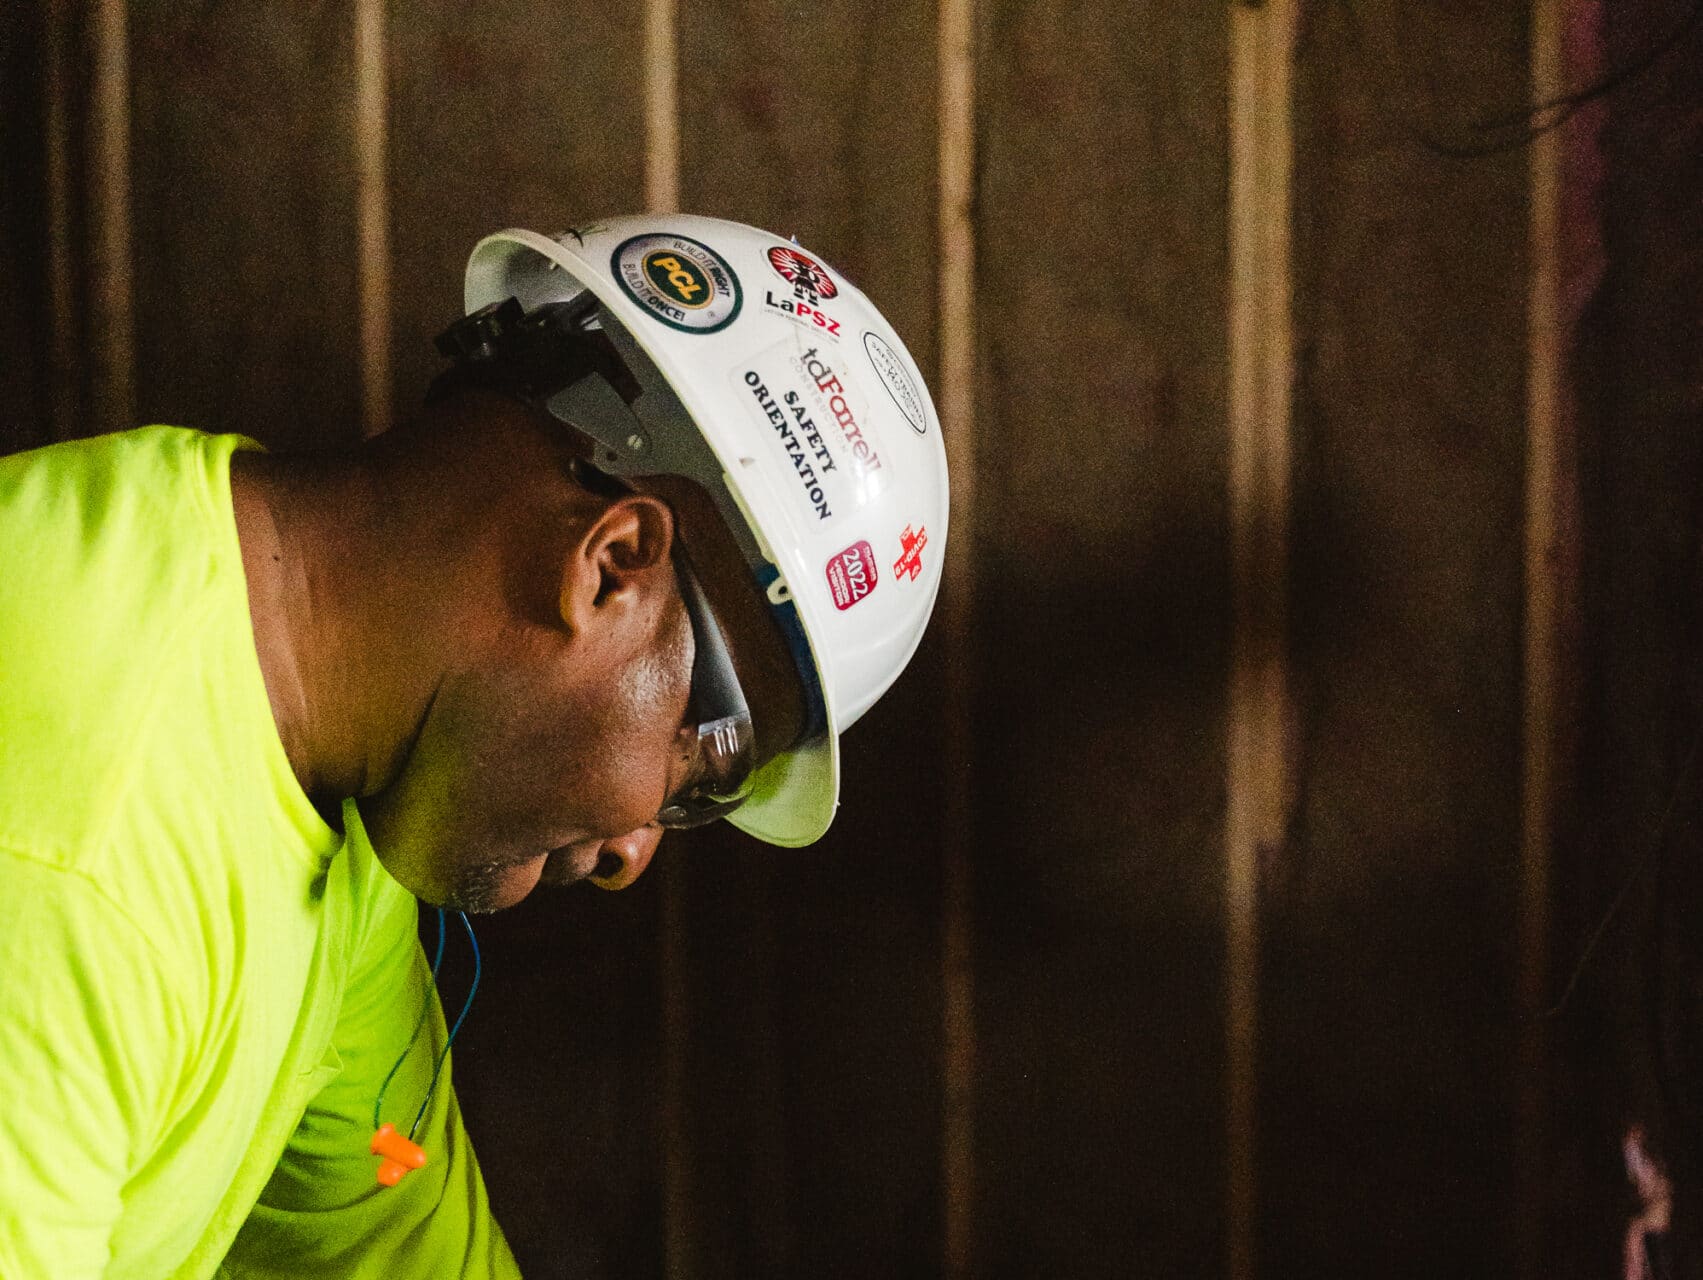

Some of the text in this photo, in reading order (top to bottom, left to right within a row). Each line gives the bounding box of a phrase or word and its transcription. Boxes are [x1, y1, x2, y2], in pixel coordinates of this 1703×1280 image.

[621, 263, 645, 290] BUILD
[647, 296, 685, 322] ONCE!
[652, 257, 702, 300] PCL
[672, 241, 706, 262] BUILD
[709, 265, 730, 298] RIGHT
[765, 290, 841, 338] LaPSZ
[783, 390, 838, 473] SAFETY
[800, 347, 882, 470] tdFarrell
[744, 370, 832, 520] ORIENTATION
[842, 548, 869, 601] 2022
